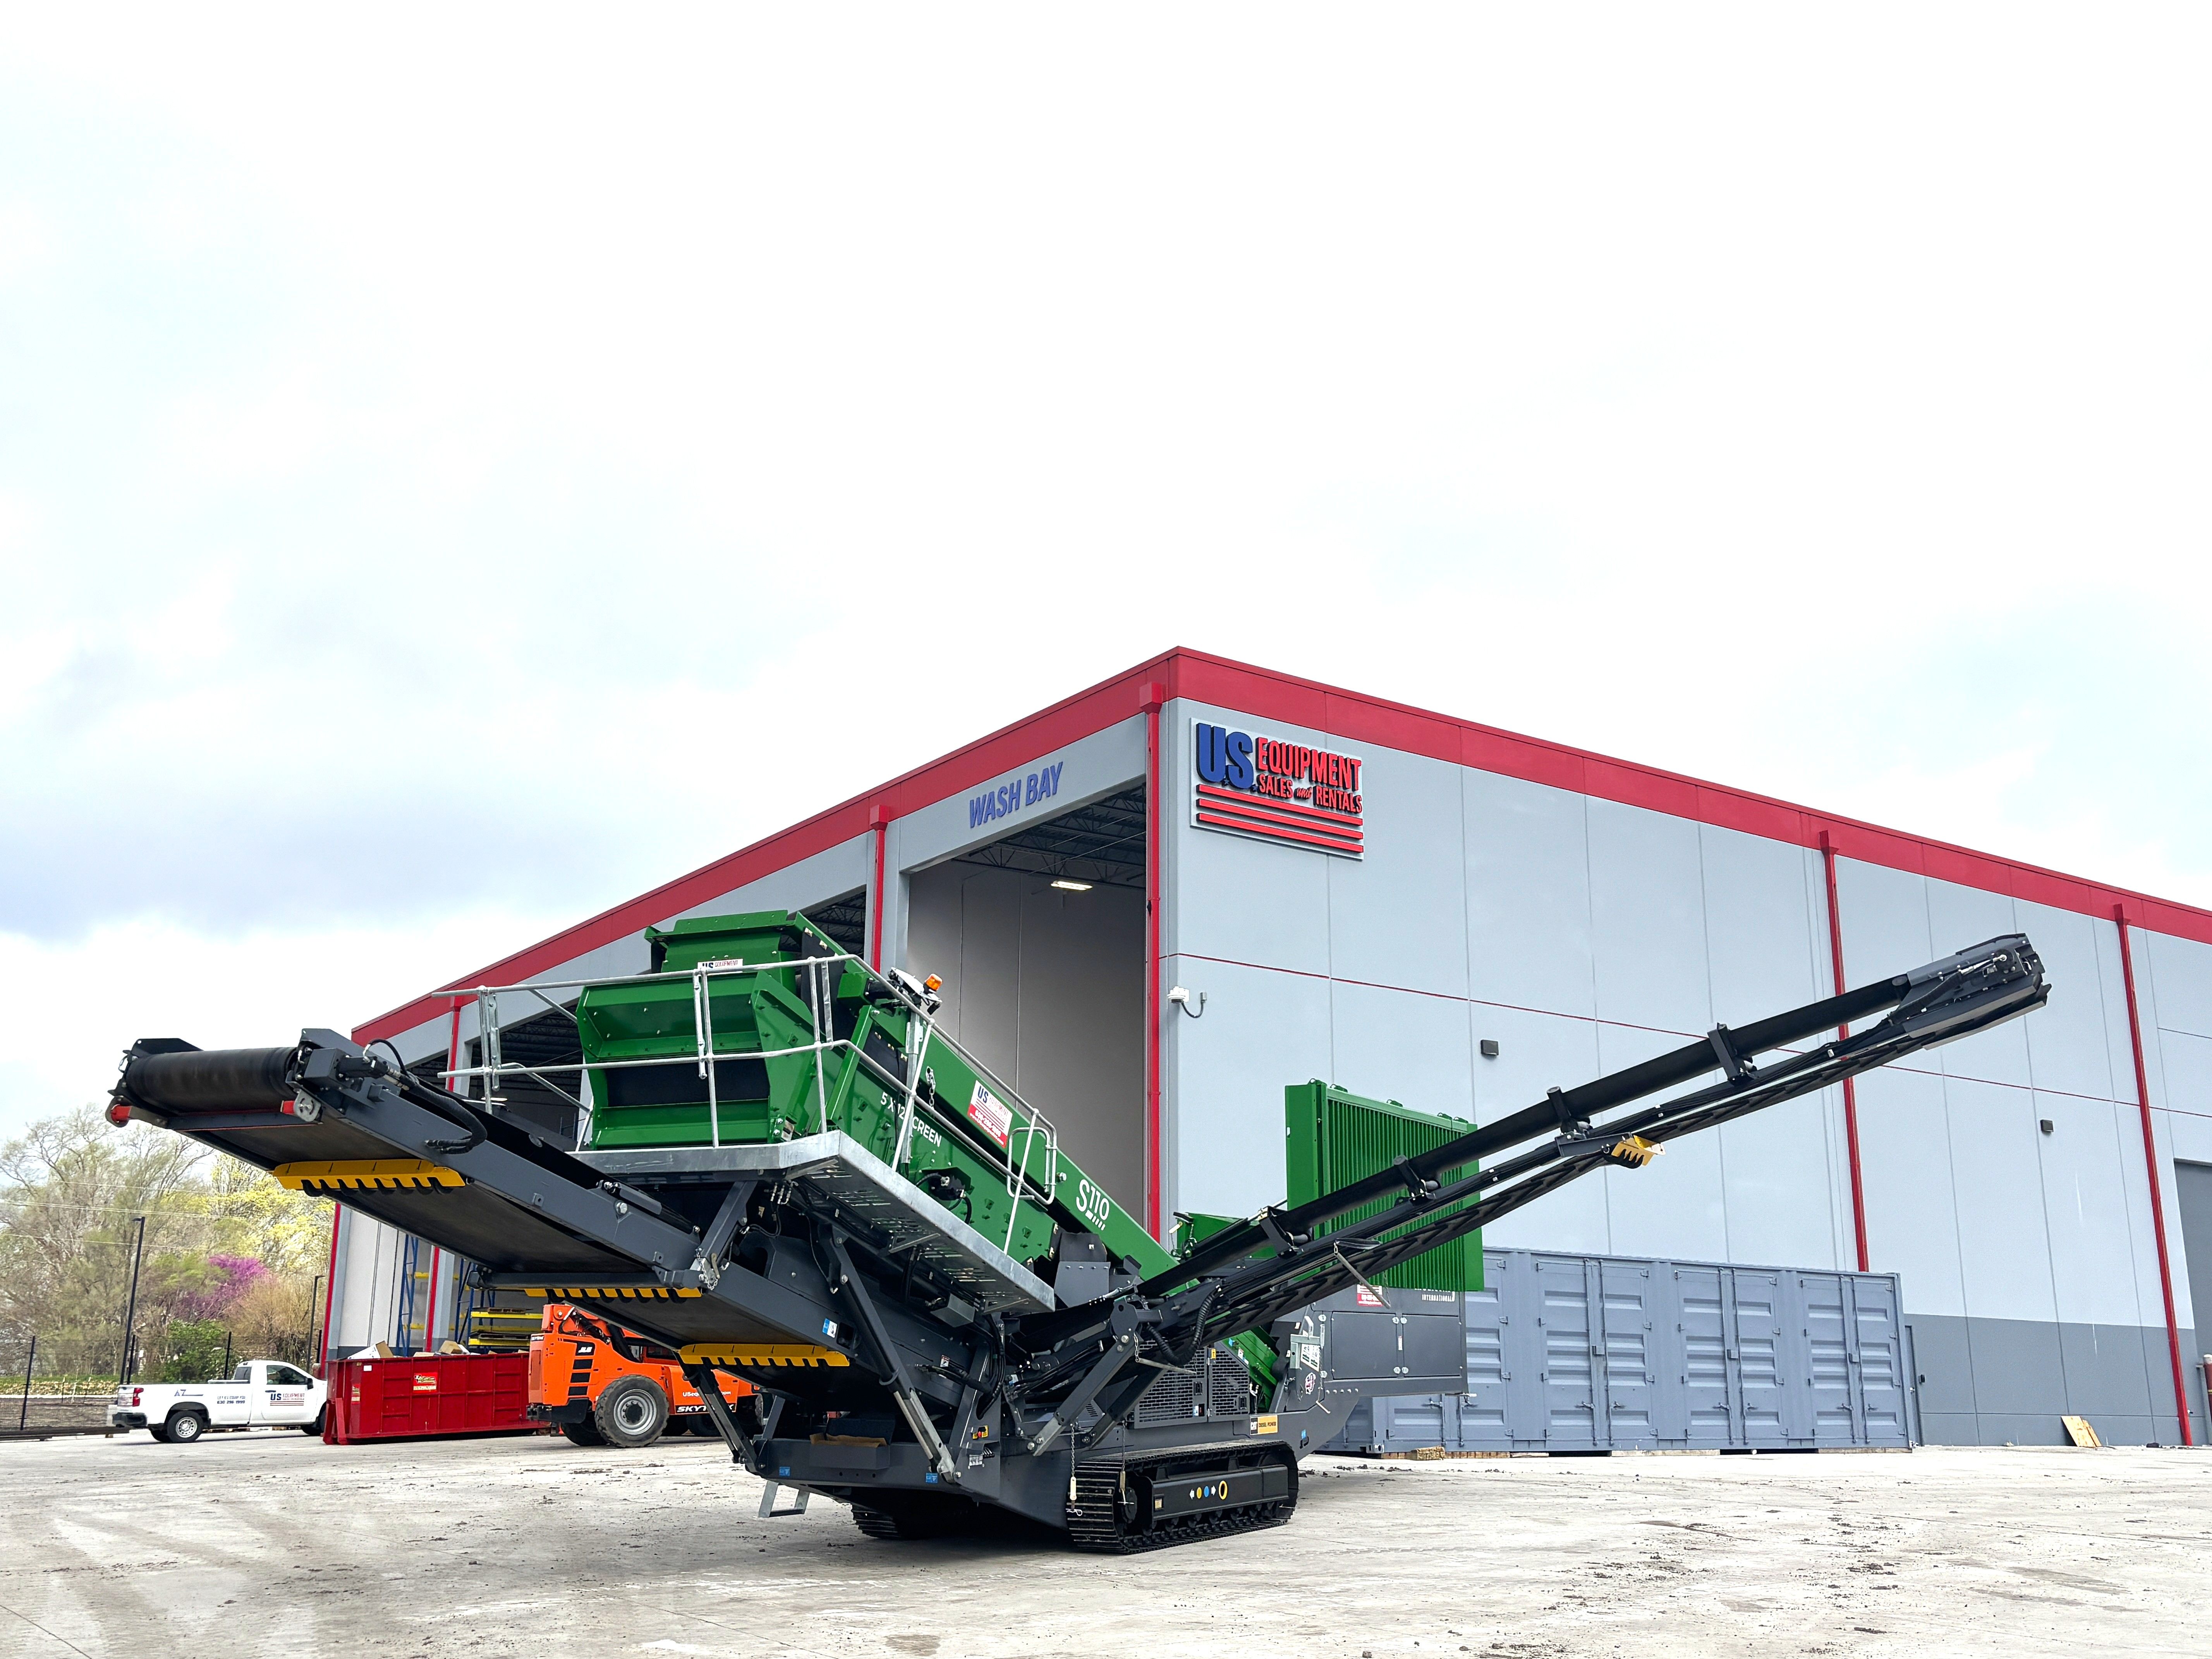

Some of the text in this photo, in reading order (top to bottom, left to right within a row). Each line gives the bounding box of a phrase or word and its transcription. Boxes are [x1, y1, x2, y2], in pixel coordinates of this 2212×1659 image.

[1256, 737, 1362, 791] EQUIPMENT
[970, 761, 1063, 828] WASH BAY
[1257, 774, 1293, 799] SALES
[1314, 786, 1362, 813] RENTALS
[978, 1085, 988, 1103] US
[881, 1092, 888, 1105] 5
[912, 1116, 942, 1147] CREEN
[1076, 1179, 1109, 1220] S110
